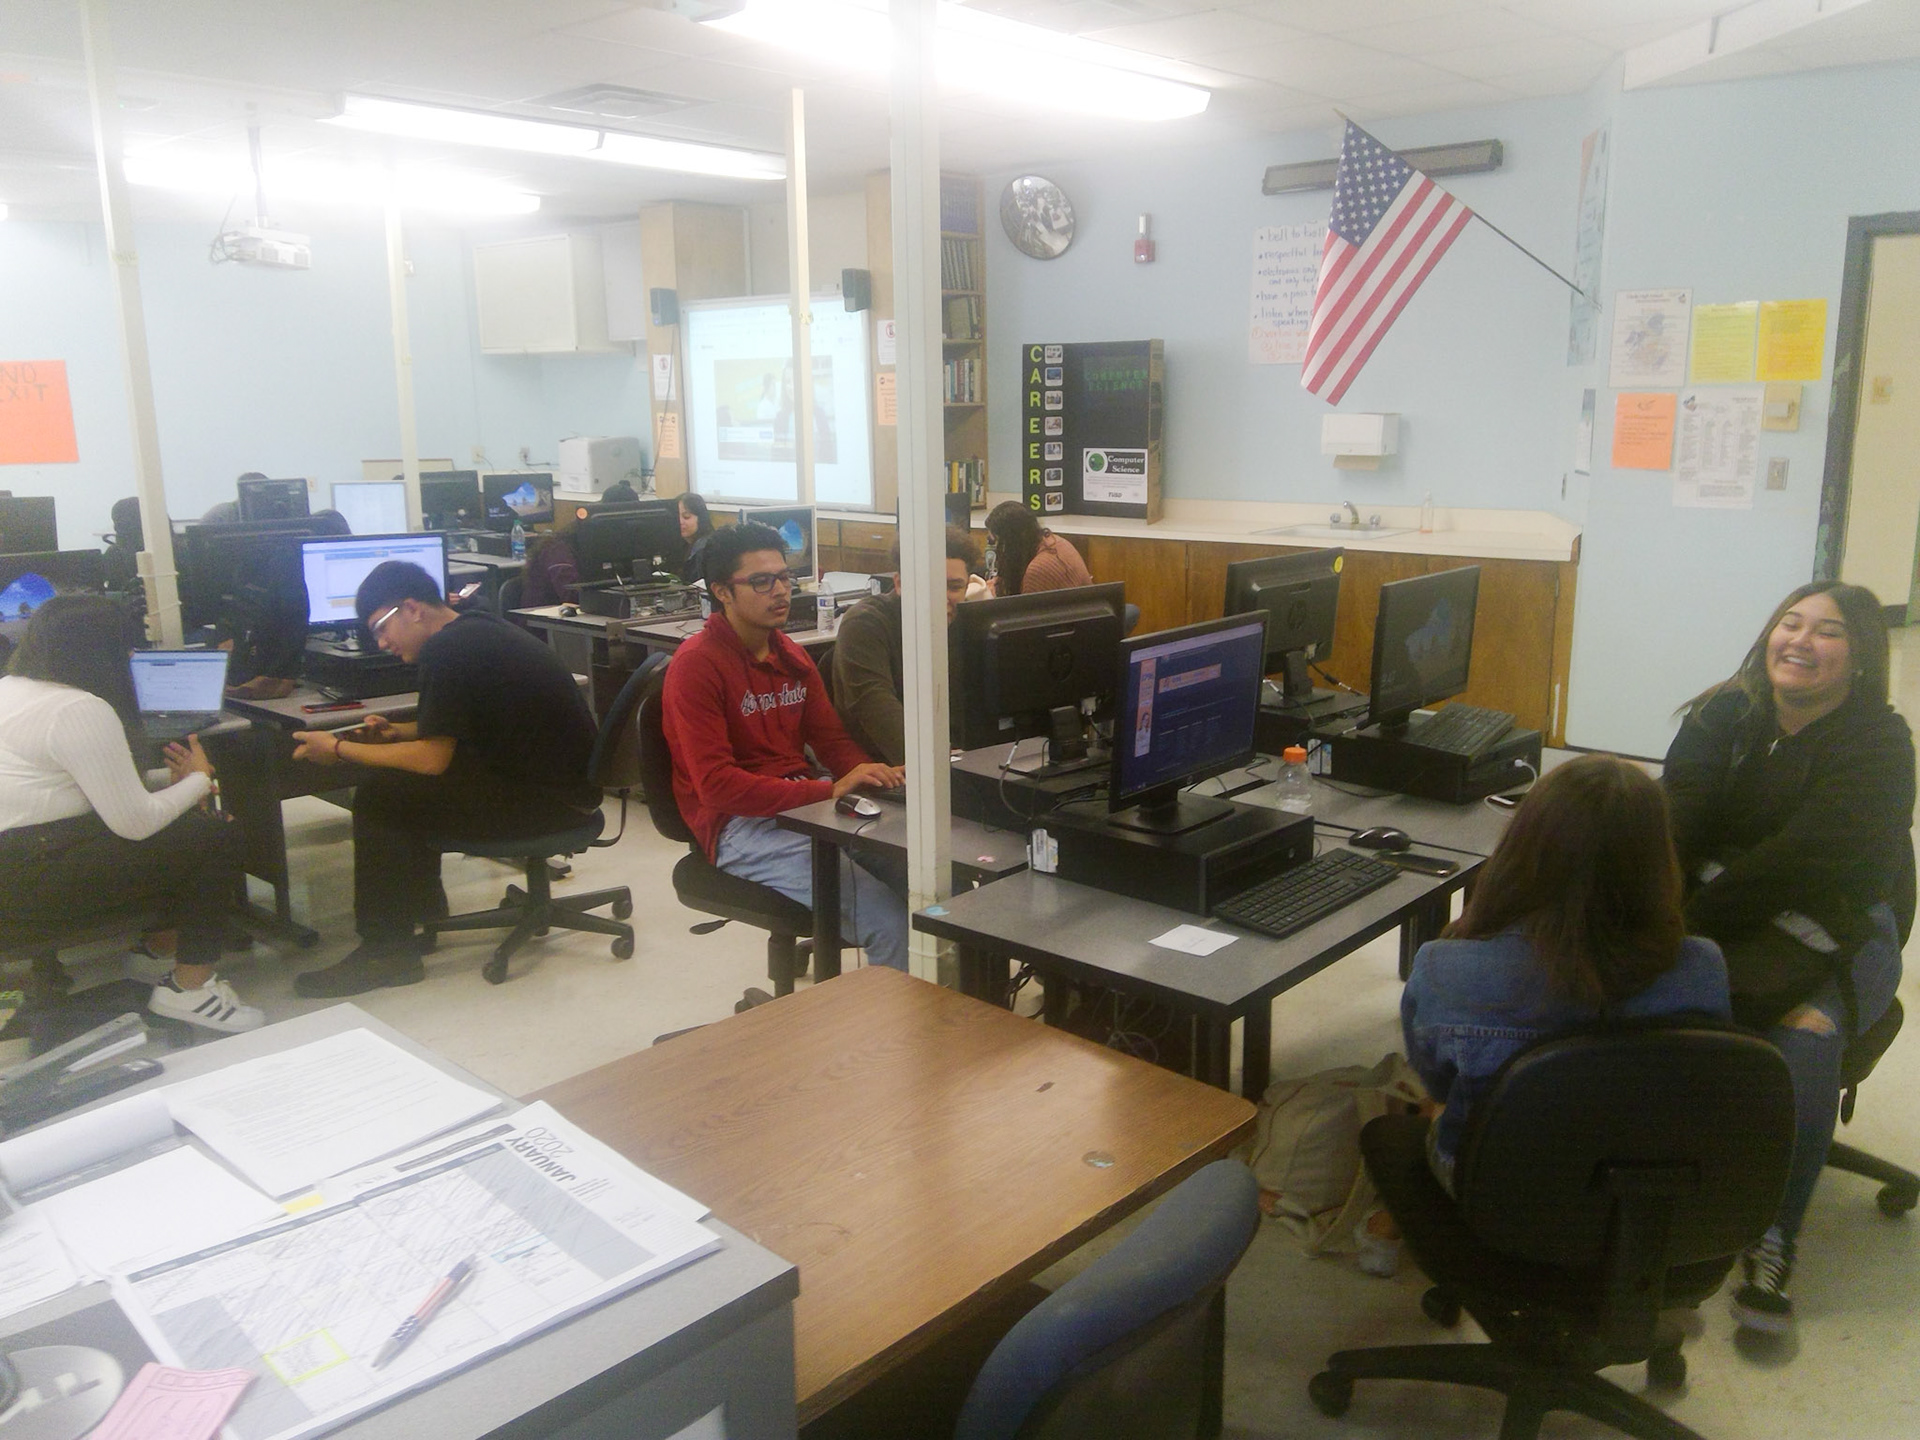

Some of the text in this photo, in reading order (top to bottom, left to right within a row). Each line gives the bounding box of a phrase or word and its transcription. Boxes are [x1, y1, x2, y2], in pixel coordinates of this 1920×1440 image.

[0, 384, 49, 403] XIT
[1029, 345, 1043, 511] CAREERS
[1107, 455, 1145, 465] Computer
[1111, 465, 1141, 474] Science
[525, 1126, 574, 1159] 2020
[505, 1136, 577, 1183] JANUARY
